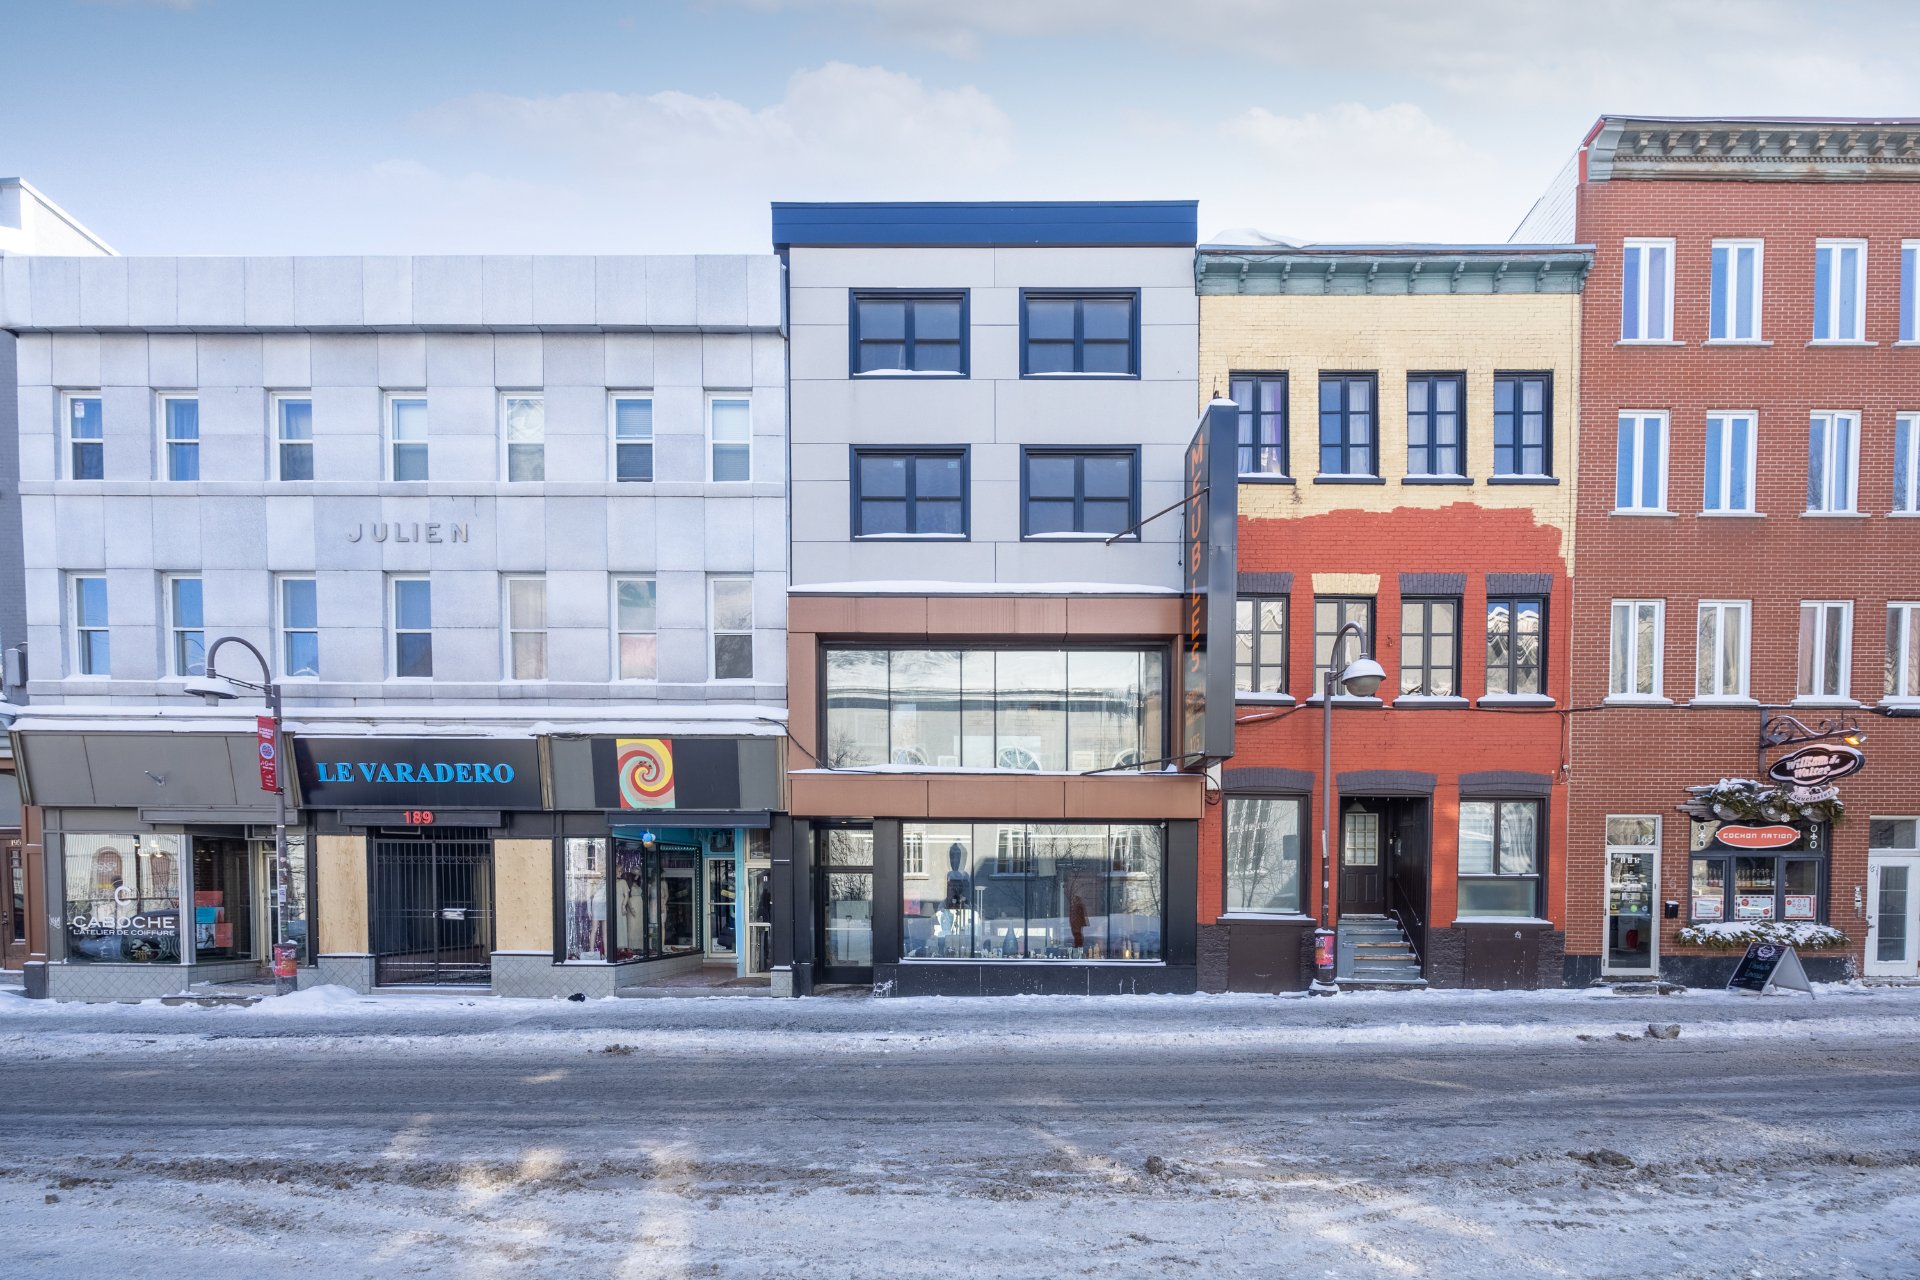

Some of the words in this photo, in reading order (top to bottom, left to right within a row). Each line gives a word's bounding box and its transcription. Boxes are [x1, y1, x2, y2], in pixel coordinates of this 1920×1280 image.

[346, 522, 469, 544] JULIEN
[1191, 433, 1204, 673] MEUBLES
[1786, 755, 1829, 770] William
[316, 762, 355, 783] LE
[357, 762, 516, 785] VARADERO
[1794, 766, 1831, 778] Walter
[403, 810, 434, 826] 189
[1761, 832, 1793, 840] NATION
[73, 916, 175, 929] CABOCHE
